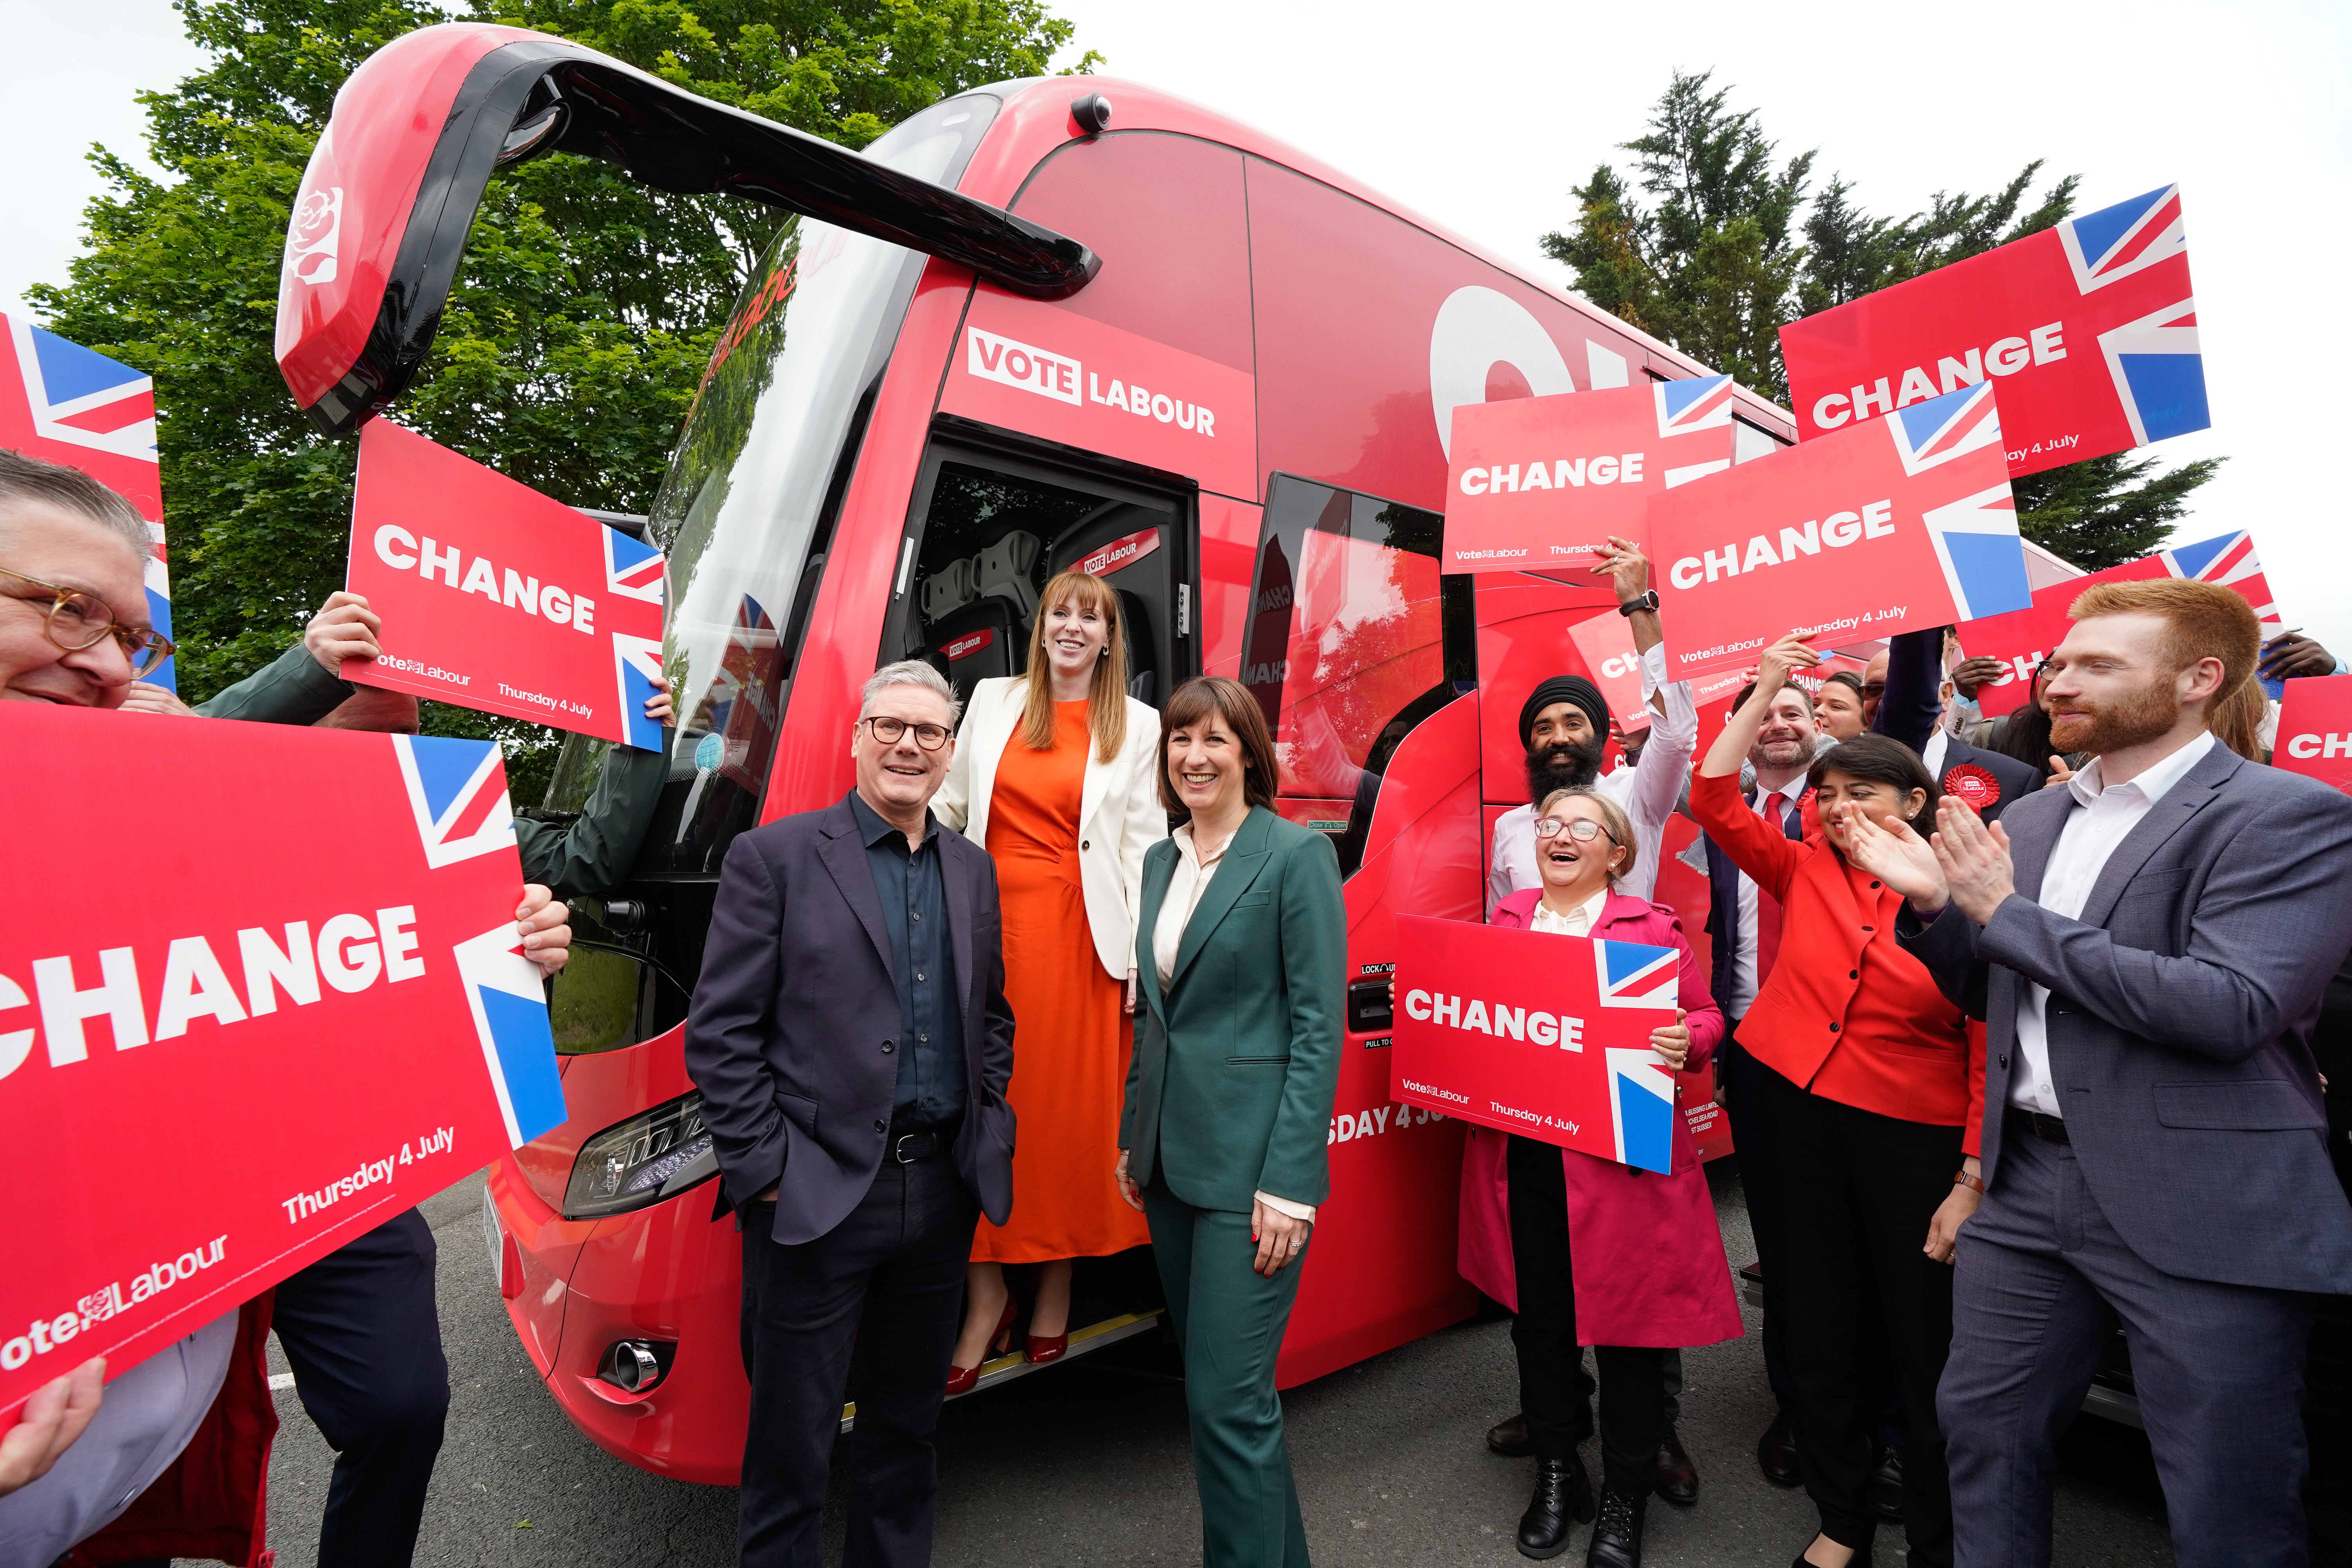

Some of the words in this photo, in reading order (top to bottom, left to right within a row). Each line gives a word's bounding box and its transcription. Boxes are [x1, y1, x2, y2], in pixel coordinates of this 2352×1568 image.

[975, 336, 1073, 395] VOTE
[1090, 372, 1215, 437] LABOUR
[1813, 321, 2067, 429] CHANGE
[2031, 443, 2042, 453] 4
[2045, 434, 2079, 451] July
[1460, 453, 1644, 495] CHANGE
[1455, 551, 1482, 559] Vote
[1491, 548, 1528, 558] Labour
[1670, 499, 1896, 590] CHANGE
[1086, 555, 1105, 573] VOTE
[1107, 543, 1136, 564] LABOUR
[374, 524, 595, 635] CHANGE
[1862, 612, 1872, 622] 4
[1875, 606, 1907, 621] July
[950, 643, 962, 655] VOTE
[963, 637, 980, 650] LABOUR
[1679, 649, 1711, 664] Vote
[1720, 637, 1765, 654] Labour
[369, 654, 407, 670] ote
[420, 662, 471, 686] Labour
[1792, 673, 1826, 692] CHANG
[1699, 675, 1739, 694] Thursday
[497, 683, 558, 711] Thursday
[559, 699, 568, 710] 4
[569, 702, 593, 719] July
[1628, 710, 1650, 721] Vote
[1362, 965, 1379, 975] LOCK
[1405, 989, 1584, 1053] CHANGE
[1402, 1079, 1427, 1093] Vote
[1435, 1087, 1470, 1104] Labour
[1396, 1103, 1411, 1128] 4
[1490, 1101, 1543, 1126] Thursday
[1544, 1116, 1553, 1126] 4
[1554, 1118, 1580, 1135] July
[1688, 1105, 1705, 1116] BUSSING
[1705, 1102, 1719, 1111] LIMITE
[1707, 1110, 1718, 1119] ROAD
[1697, 1121, 1712, 1132] SUSSEX
[282, 1154, 395, 1224] Thursday
[399, 1143, 414, 1165] 4
[416, 1126, 454, 1160] July
[0, 1311, 80, 1371] ote
[110, 1234, 228, 1314] Labour
